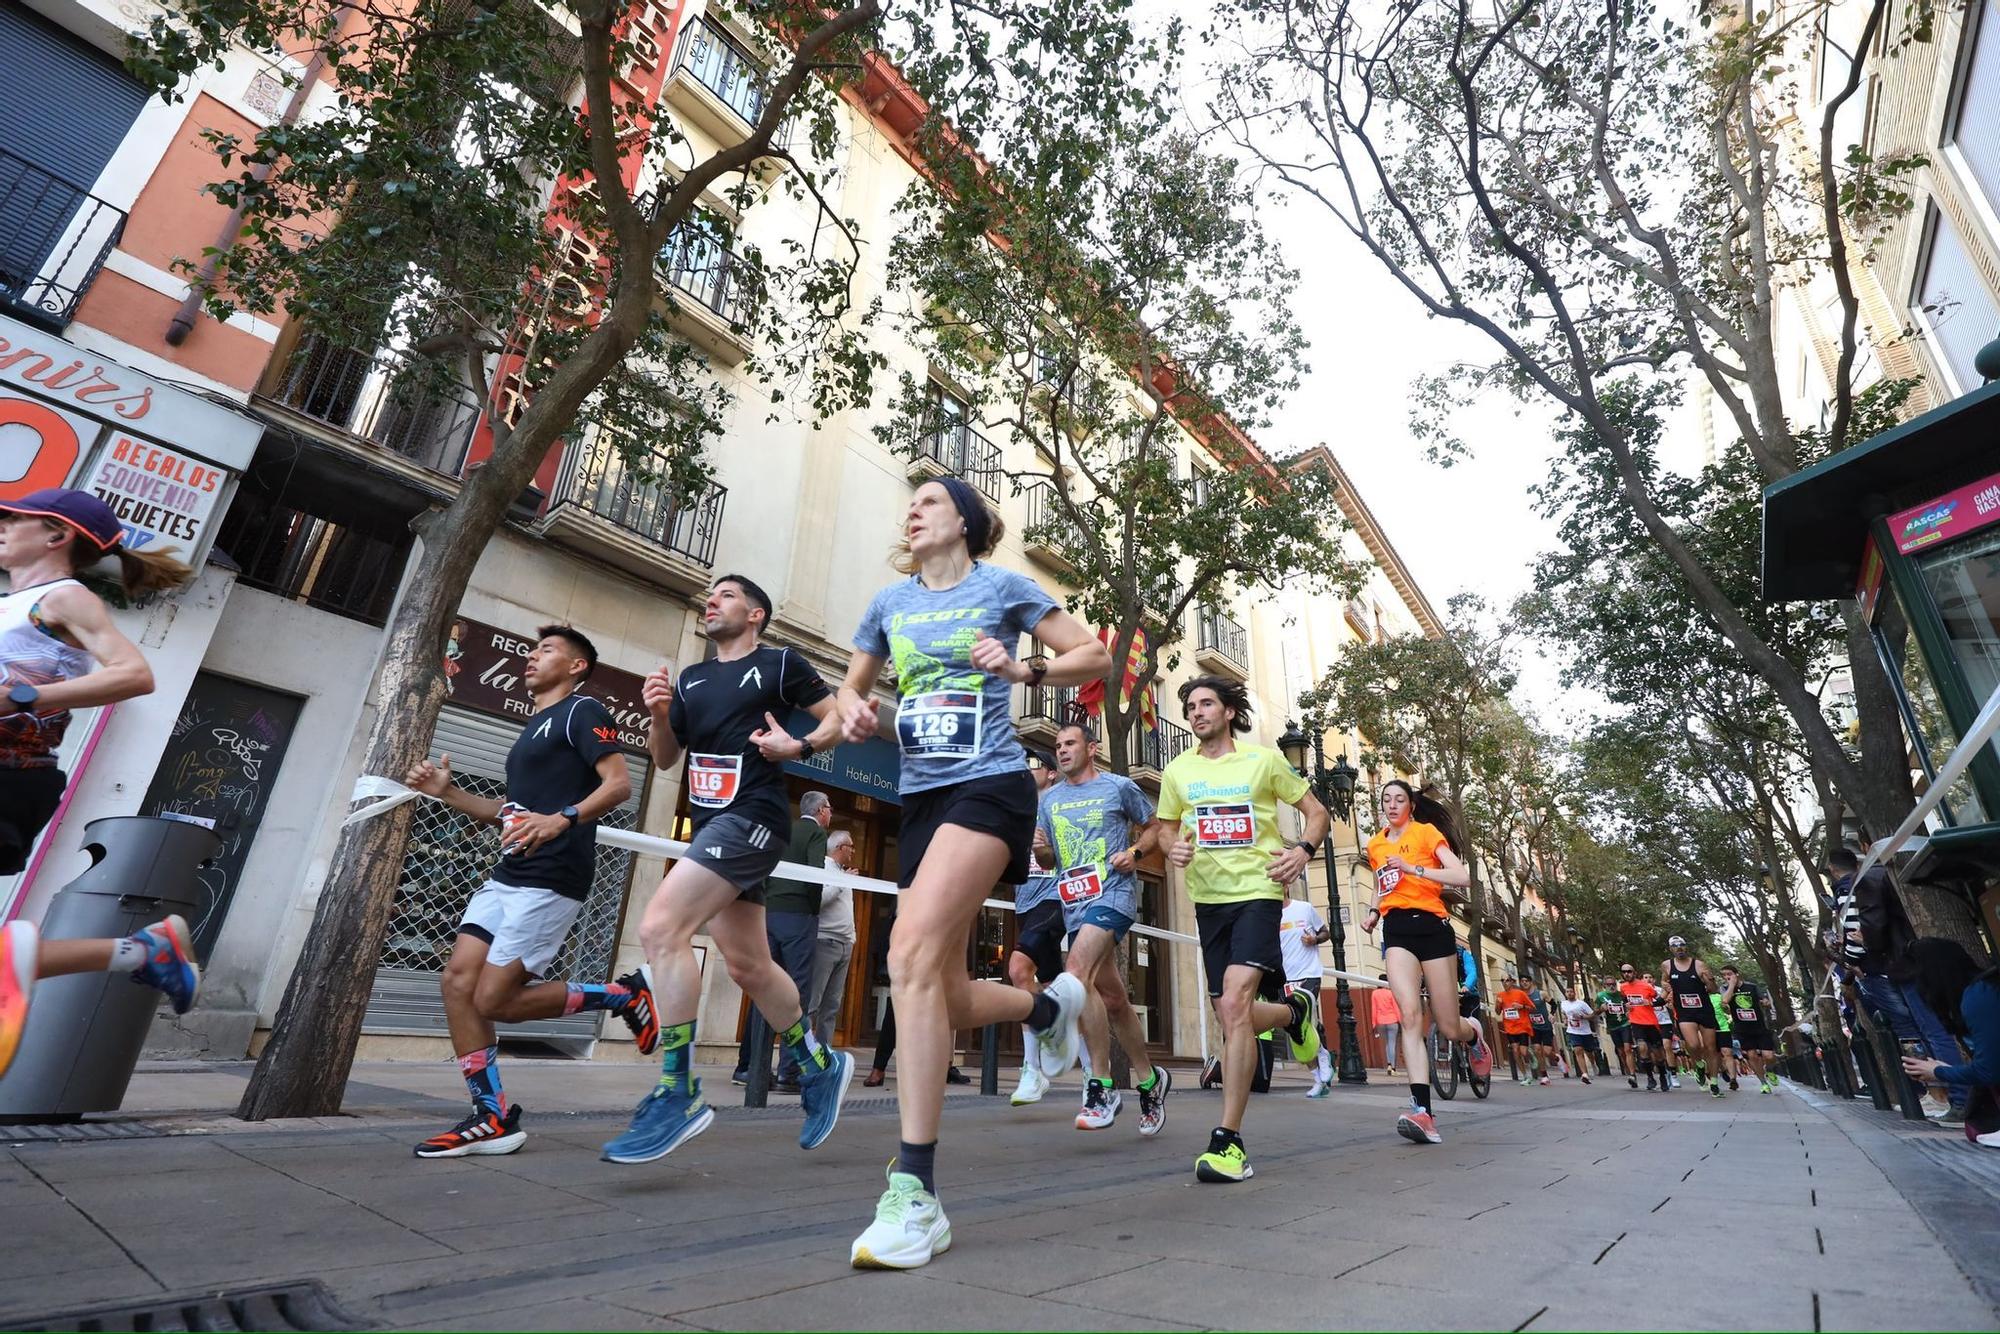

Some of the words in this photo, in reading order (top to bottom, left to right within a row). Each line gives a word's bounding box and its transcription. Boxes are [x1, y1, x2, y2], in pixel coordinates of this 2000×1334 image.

[112, 437, 220, 493] REGALOS
[96, 462, 199, 514] SOUVENIR
[1905, 508, 1951, 532] RASCAS
[903, 608, 987, 624] SCOTT
[912, 714, 959, 737] 126
[693, 772, 723, 791] 116
[846, 766, 872, 784] Hotel
[873, 774, 893, 790] Don
[1187, 781, 1207, 791] 10K
[1202, 819, 1248, 834] 2696
[1065, 878, 1091, 895] 601
